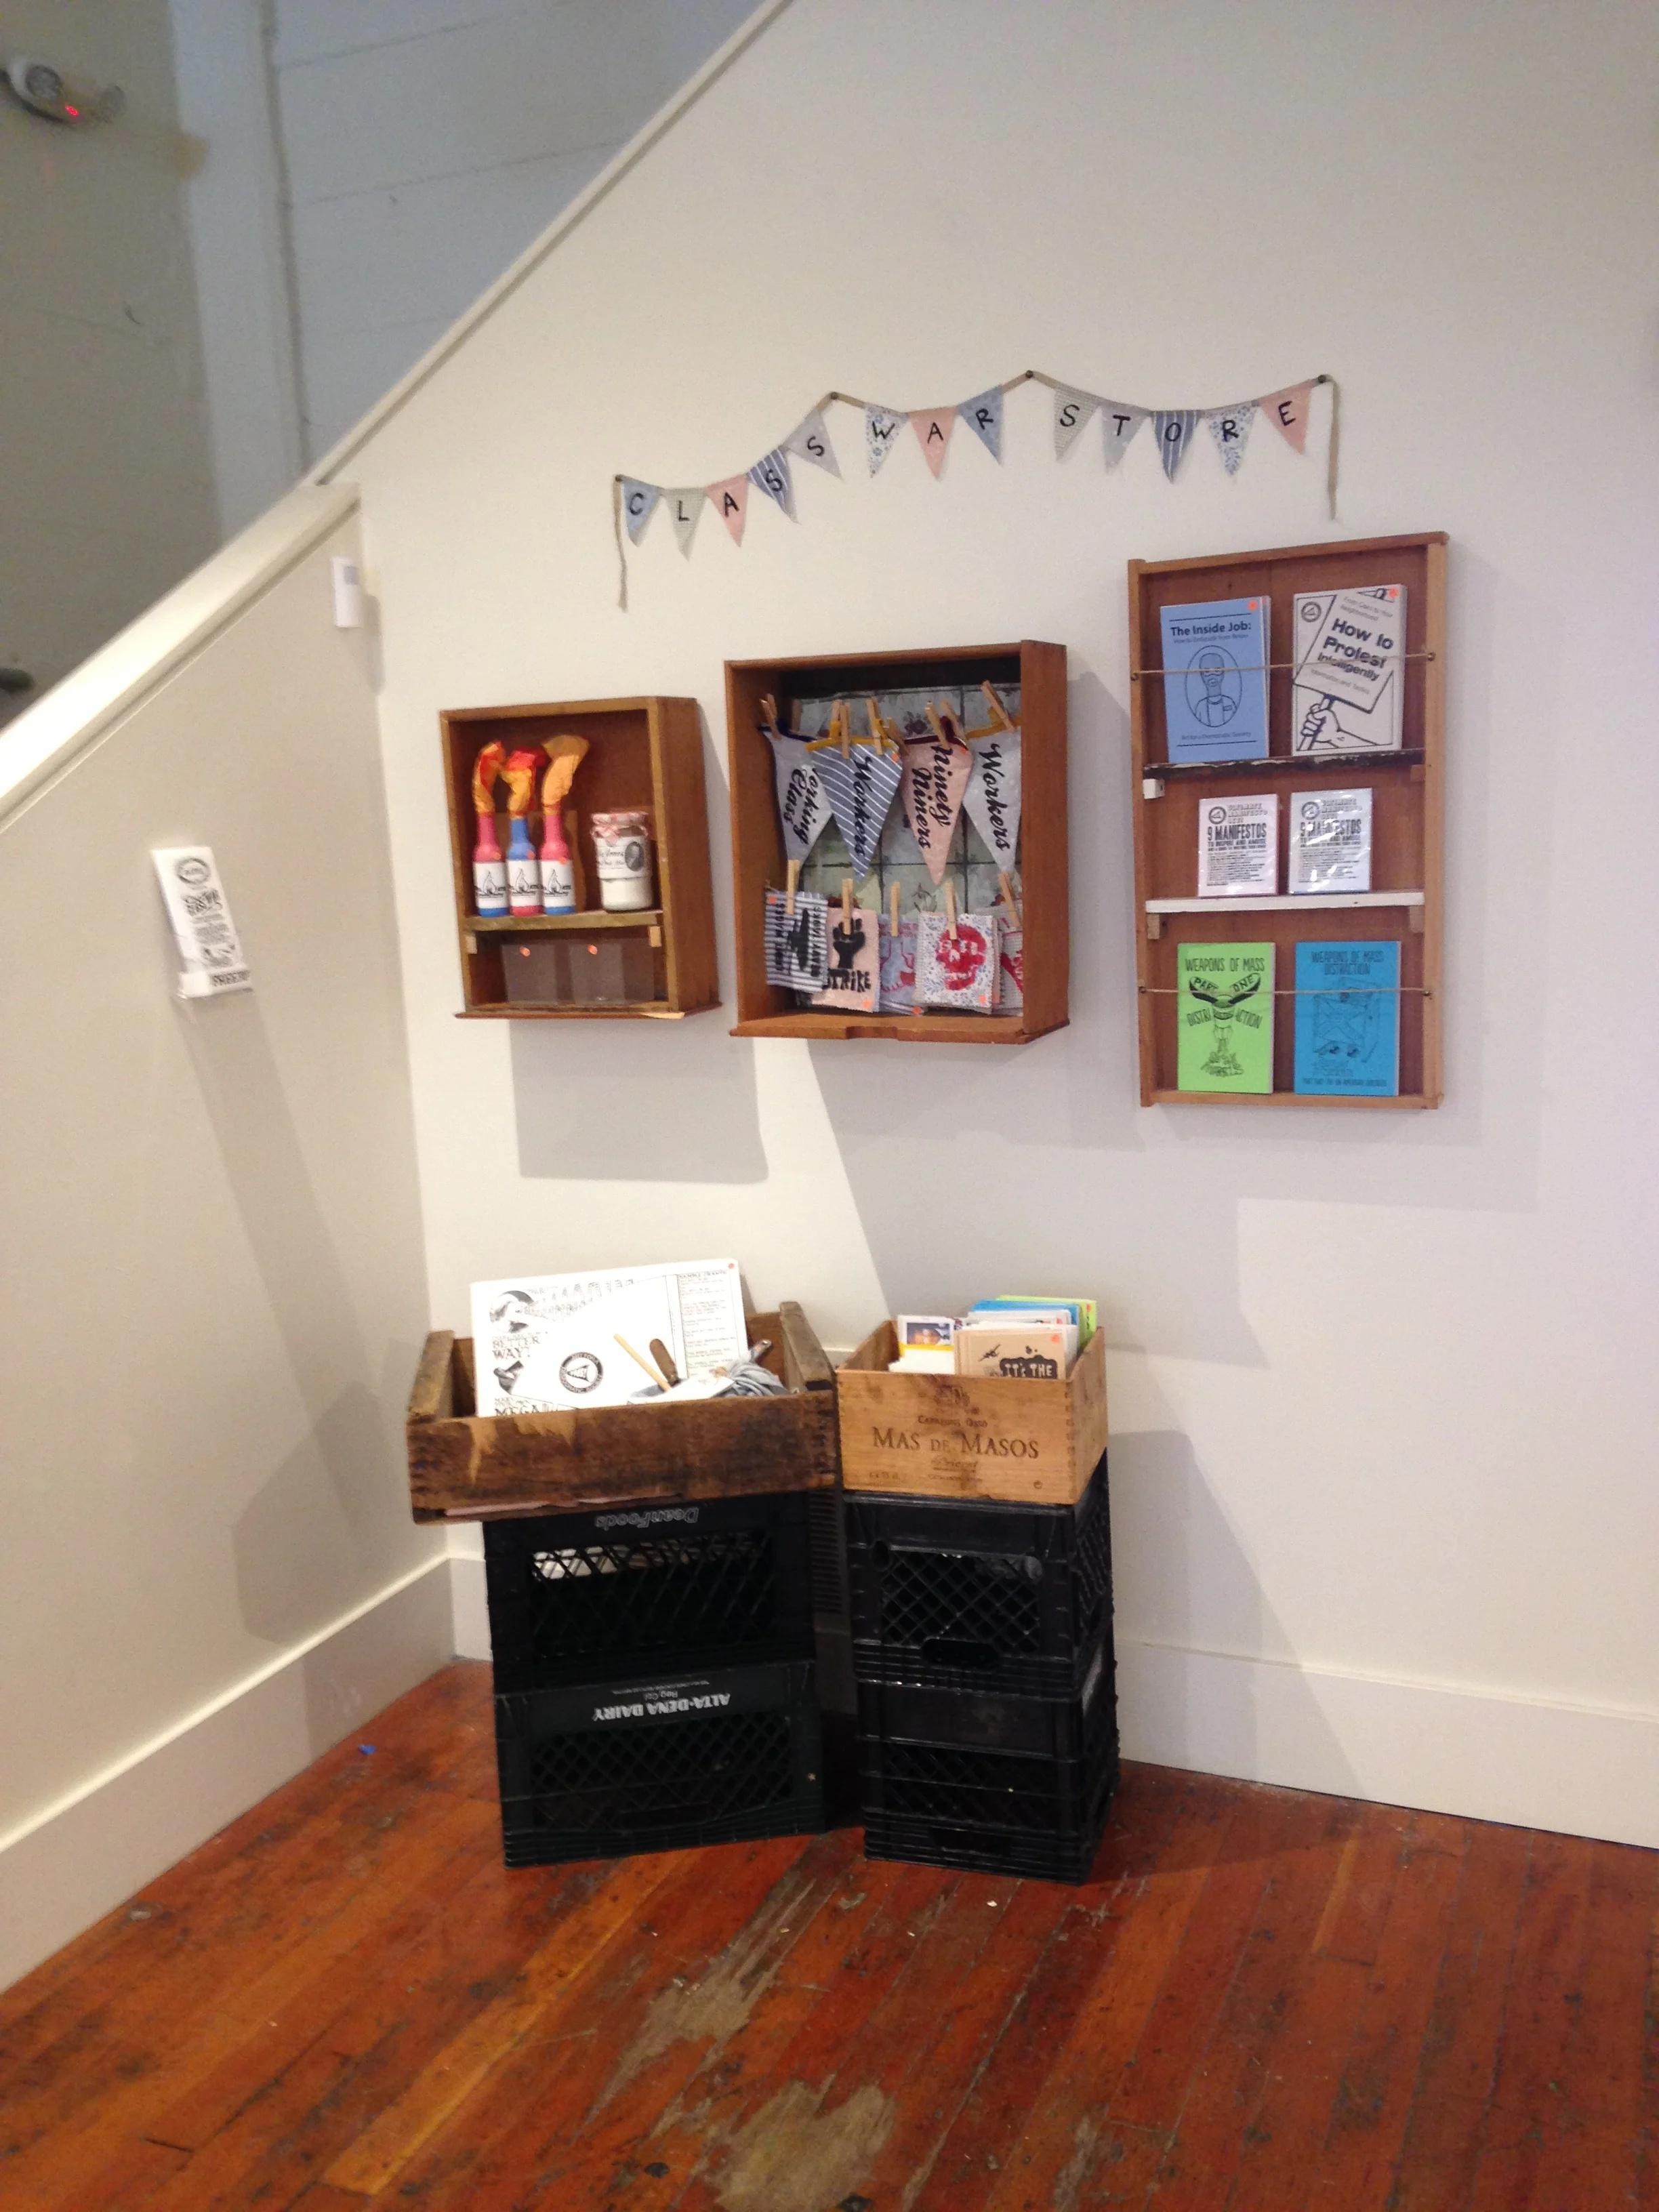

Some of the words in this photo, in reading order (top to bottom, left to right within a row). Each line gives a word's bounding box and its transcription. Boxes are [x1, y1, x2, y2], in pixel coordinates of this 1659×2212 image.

[628, 435, 825, 523] CLASS
[872, 406, 994, 445] WAR
[1059, 400, 1296, 443] STORE
[1170, 626, 1191, 636] The
[1193, 623, 1225, 635] Inside
[1228, 621, 1252, 632] Job:
[1332, 617, 1372, 641] How
[1376, 633, 1394, 650] to
[1323, 636, 1387, 669] Protest
[783, 769, 807, 825] Class
[793, 768, 820, 845] orking
[853, 756, 874, 857] Workers
[979, 743, 1010, 852] Workers
[1208, 826, 1212, 840] 9
[1215, 823, 1267, 841] MANIFESTOS
[1185, 958, 1225, 972] WEAPONS
[1230, 958, 1240, 972] OF
[1242, 958, 1265, 972] MASS
[1233, 975, 1253, 992] ONE
[1029, 1364, 1052, 1378] THE
[872, 1425, 922, 1452] MAS
[960, 1431, 1040, 1459] MASOS
[592, 1703, 644, 1722] DAIRY
